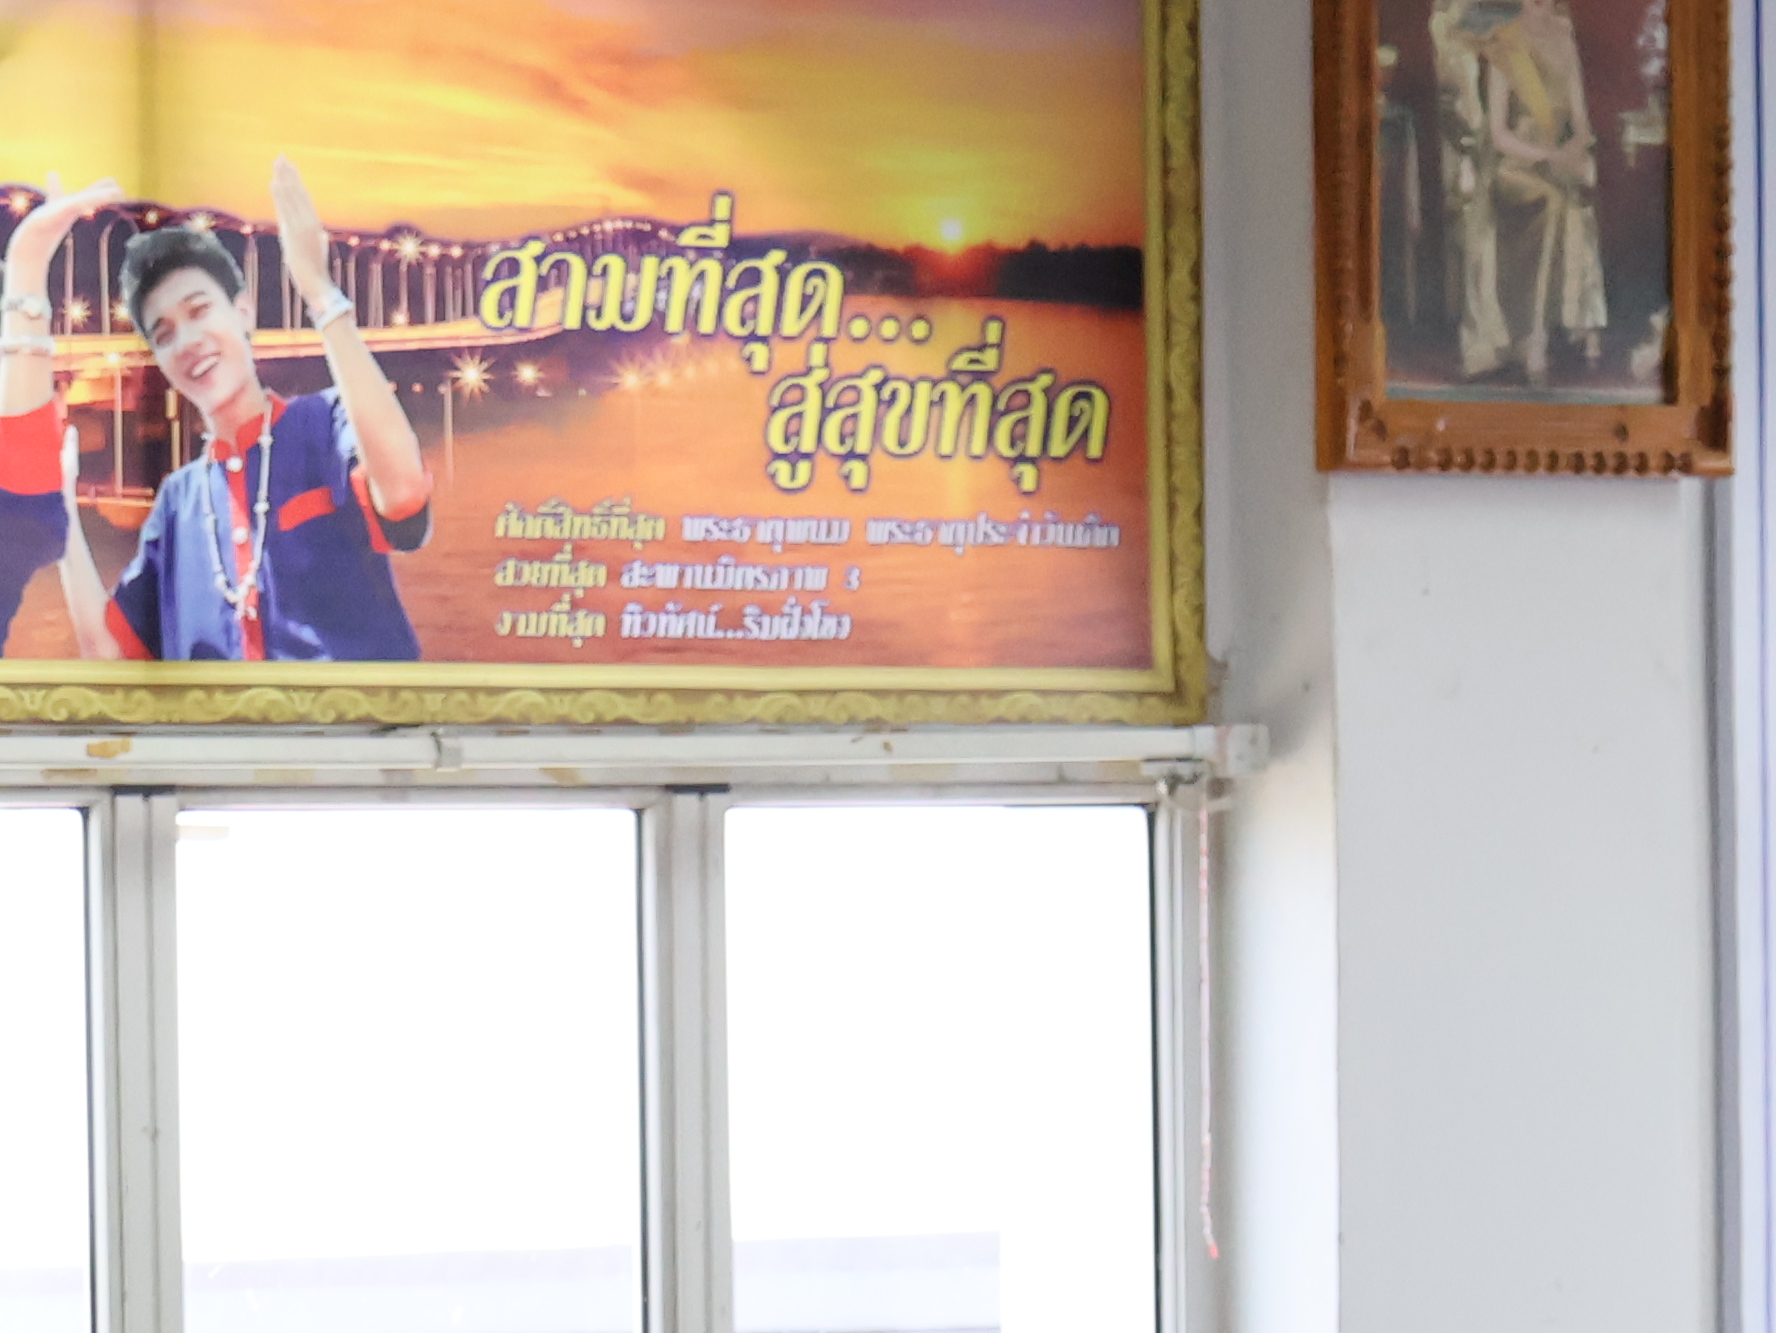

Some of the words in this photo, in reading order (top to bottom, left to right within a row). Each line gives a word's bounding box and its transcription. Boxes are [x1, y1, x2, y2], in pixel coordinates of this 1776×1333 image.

[766, 320, 1110, 492] สู่สุขที่สุด
[843, 566, 861, 591] 3
